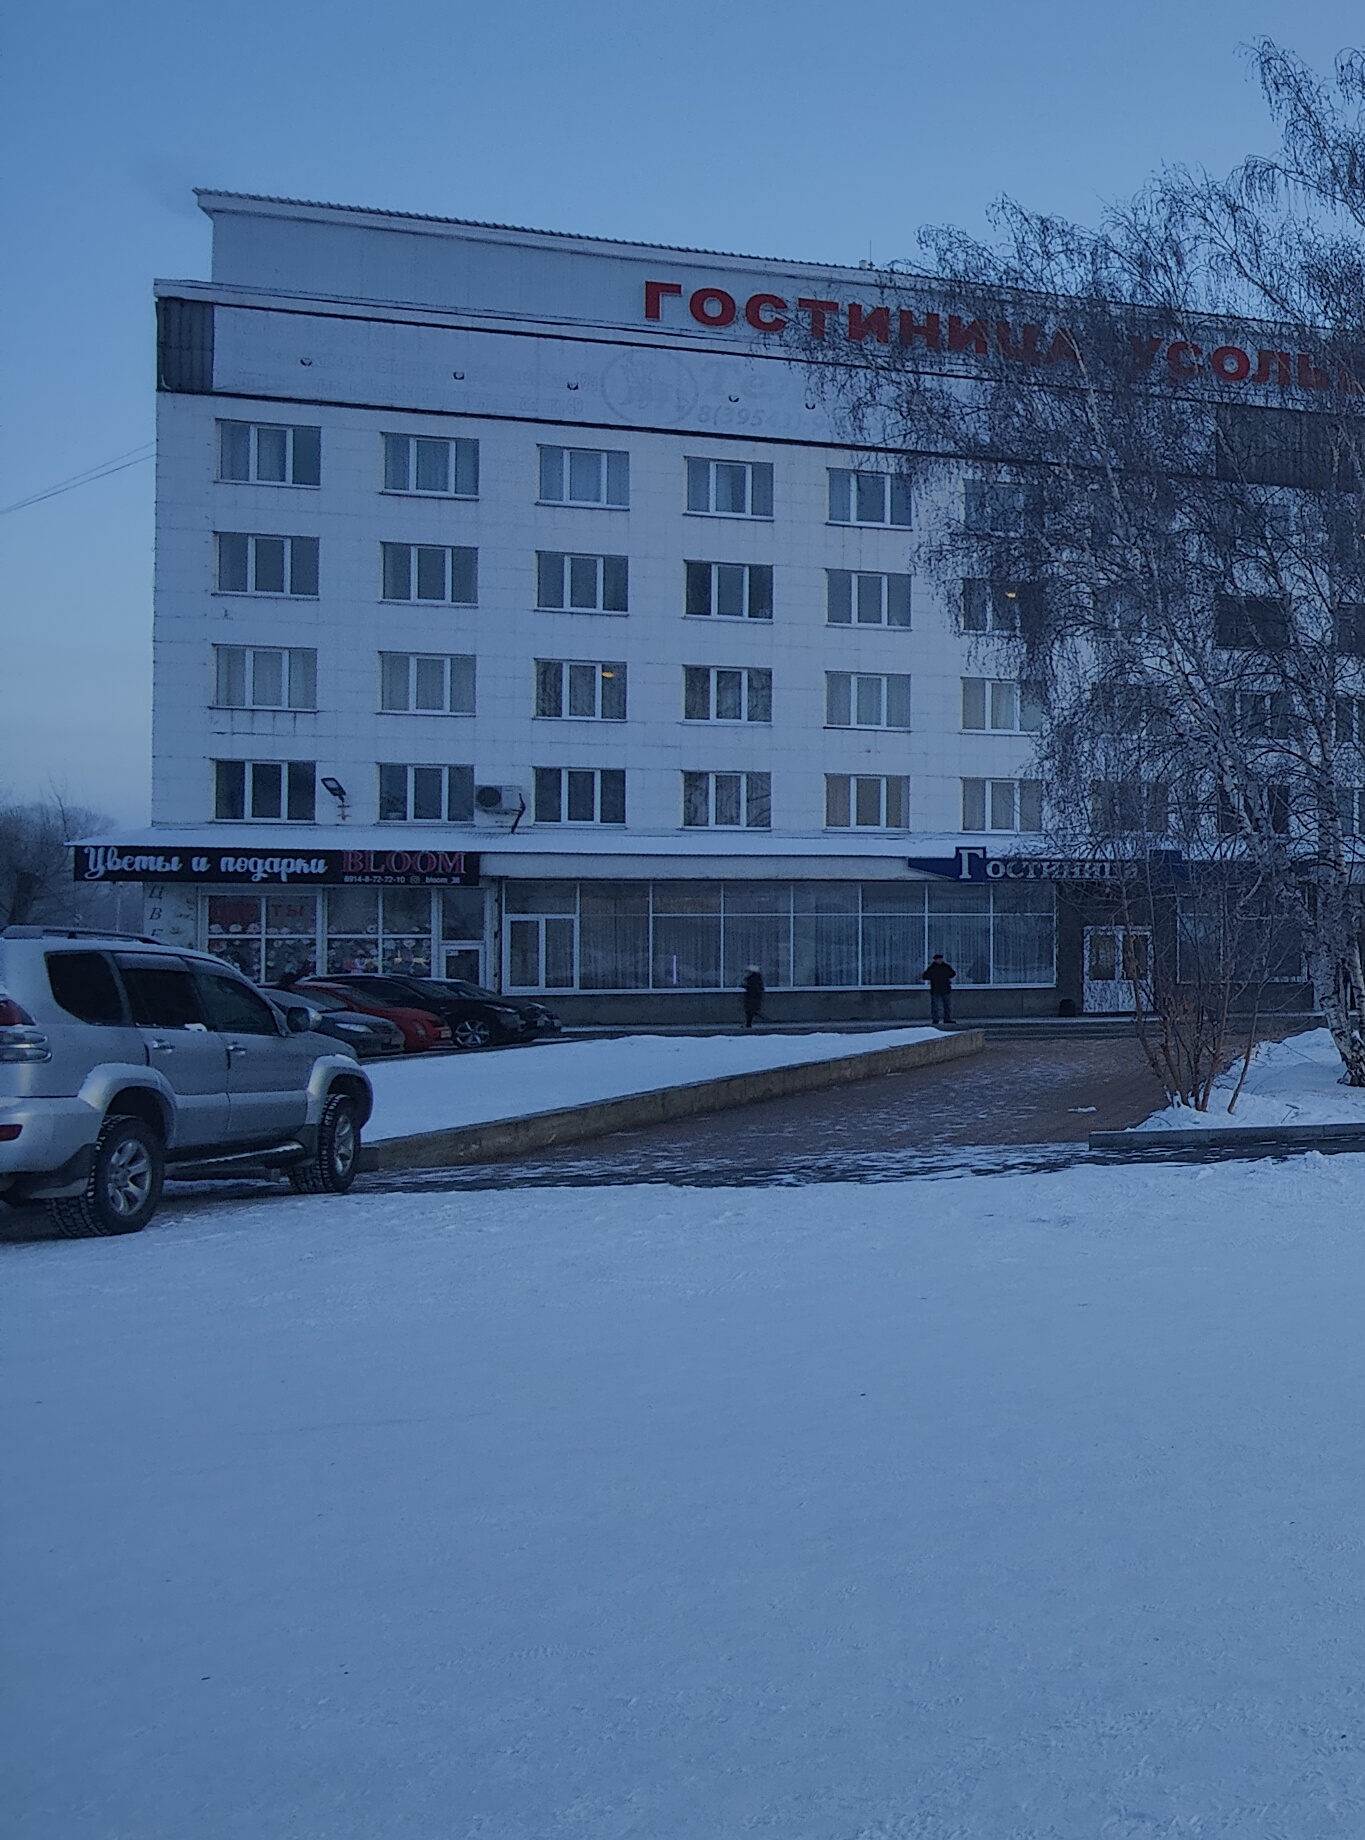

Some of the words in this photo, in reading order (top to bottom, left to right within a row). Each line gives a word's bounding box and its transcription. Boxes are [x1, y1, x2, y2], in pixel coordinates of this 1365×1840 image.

[643, 280, 1078, 365] ГОСТИНИЦА
[83, 847, 183, 880] Цветы
[191, 856, 210, 872] и
[220, 856, 328, 882] подарки
[341, 849, 467, 874] BLOOM
